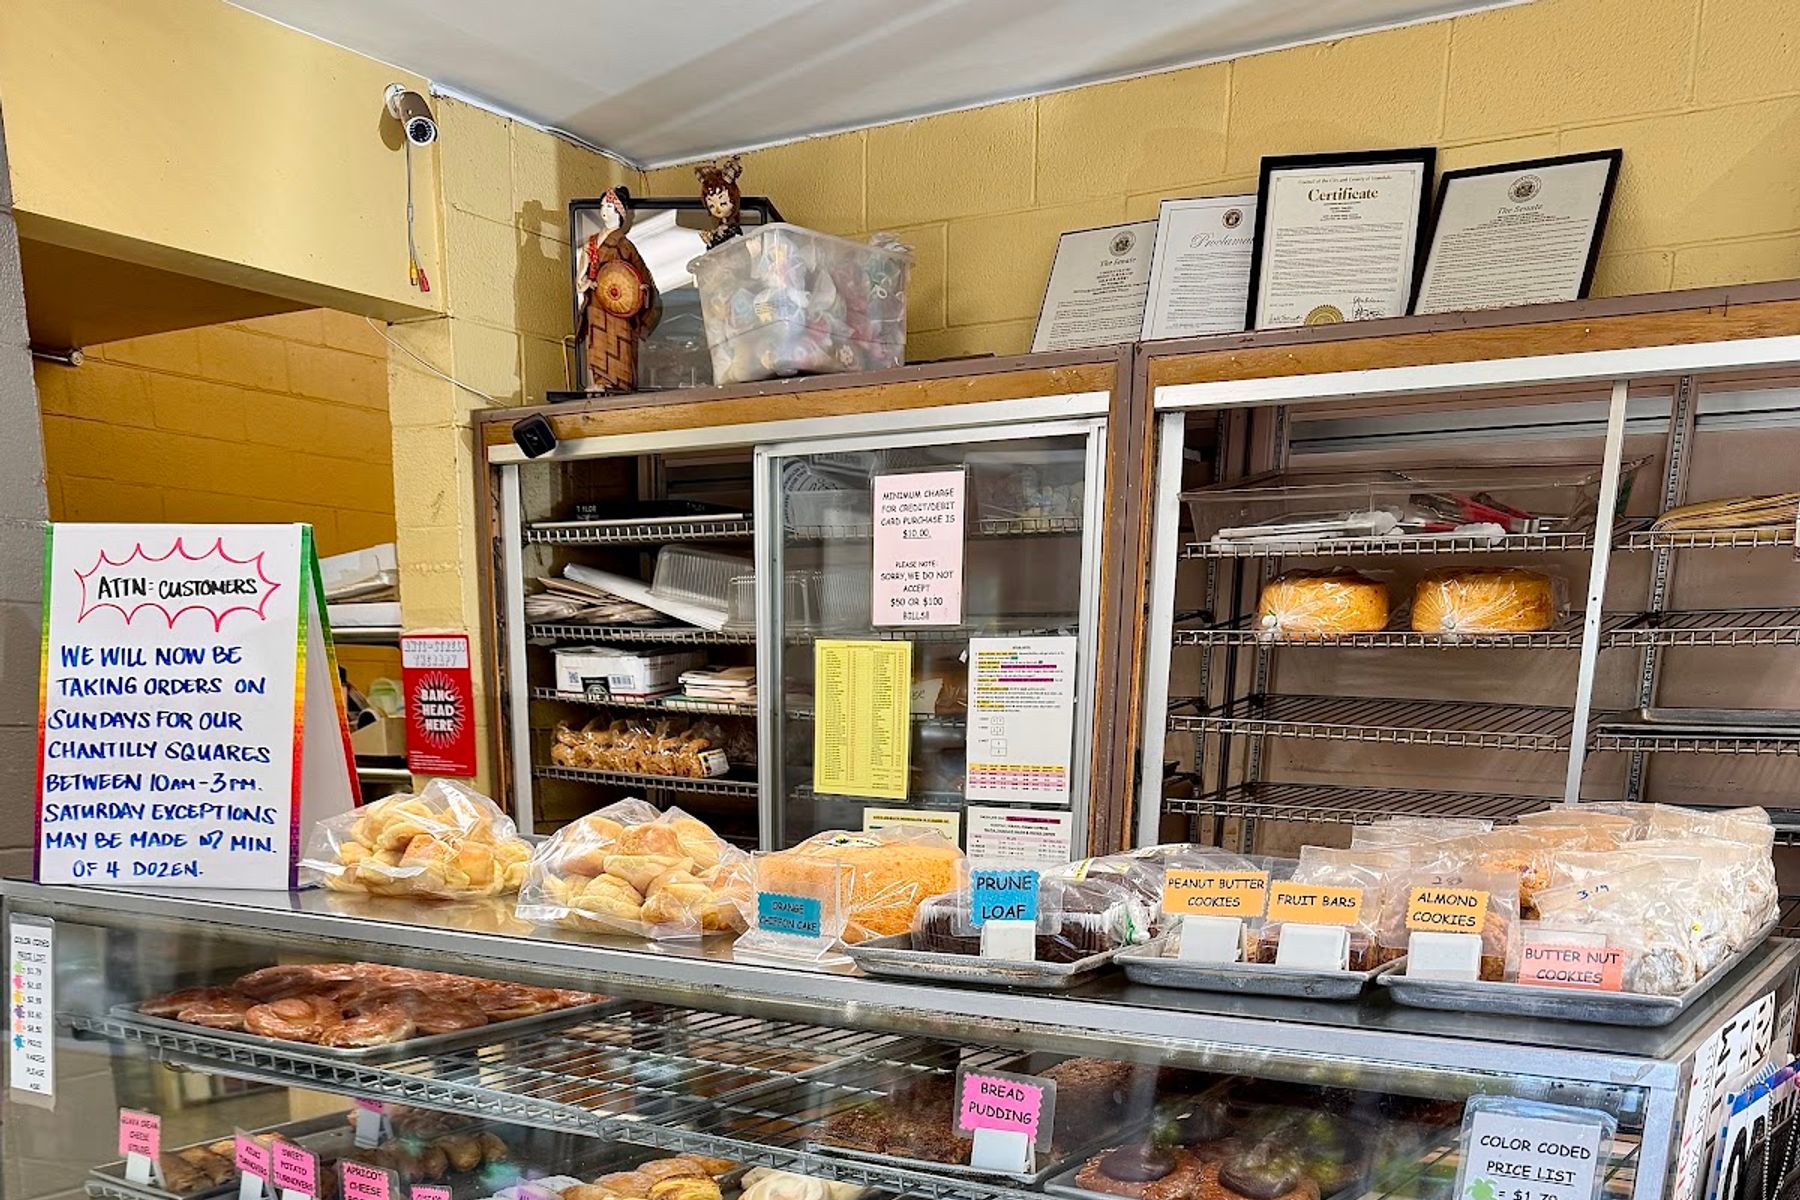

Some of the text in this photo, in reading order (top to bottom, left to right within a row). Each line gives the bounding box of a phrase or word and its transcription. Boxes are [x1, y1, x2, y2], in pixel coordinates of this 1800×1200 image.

[1308, 187, 1379, 202] Certificate
[882, 488, 954, 500] MINIMUM CHARGE
[881, 504, 897, 513] FOR
[881, 514, 956, 526] CARD PURCHASE IS
[895, 560, 917, 568] PLEASE
[922, 571, 935, 580] DO
[936, 570, 954, 579] NOT
[158, 577, 258, 599] CUSTOMERS
[903, 584, 931, 592] ACCEPT
[890, 596, 944, 607] $50 OR $100
[61, 645, 243, 667] WE WILL NOW BE
[56, 676, 267, 697] TAKING ORDERS ON
[419, 688, 456, 702] BANG
[421, 703, 455, 717] HEAD
[48, 710, 244, 732] SUNDAYS FOR OUR
[424, 718, 455, 732] HERE
[47, 740, 272, 764] CHANTILLY SQUARES
[45, 772, 142, 793] BETWEEN
[44, 803, 278, 825] SATURDAY EXCEPTIONS
[45, 832, 87, 850] MAY
[95, 832, 122, 849] BE
[129, 833, 189, 849] MADE
[230, 835, 277, 854] MIN.
[73, 860, 205, 878] OF 4 DOZEN.
[976, 876, 1032, 891] PRUNE
[1168, 877, 1265, 891] PEANUT BUTTER
[1188, 896, 1241, 908] COOKIES
[1277, 893, 1356, 908] FRUIT BARS
[1417, 892, 1478, 907] ALMOND
[982, 904, 1026, 920] LOAF
[1412, 911, 1476, 927] COOKIES
[1525, 947, 1620, 965] BUTTER NUT
[1536, 969, 1604, 984] COOKIES
[981, 1082, 1025, 1102] BREAD
[968, 1101, 1033, 1125] PUDDING
[1480, 1134, 1591, 1160] COLOR CODED
[280, 1161, 307, 1175] POTATO
[346, 1165, 383, 1180] APRICOT
[1486, 1160, 1577, 1183] PRICE LIST
[349, 1181, 382, 1197] CHEESE
